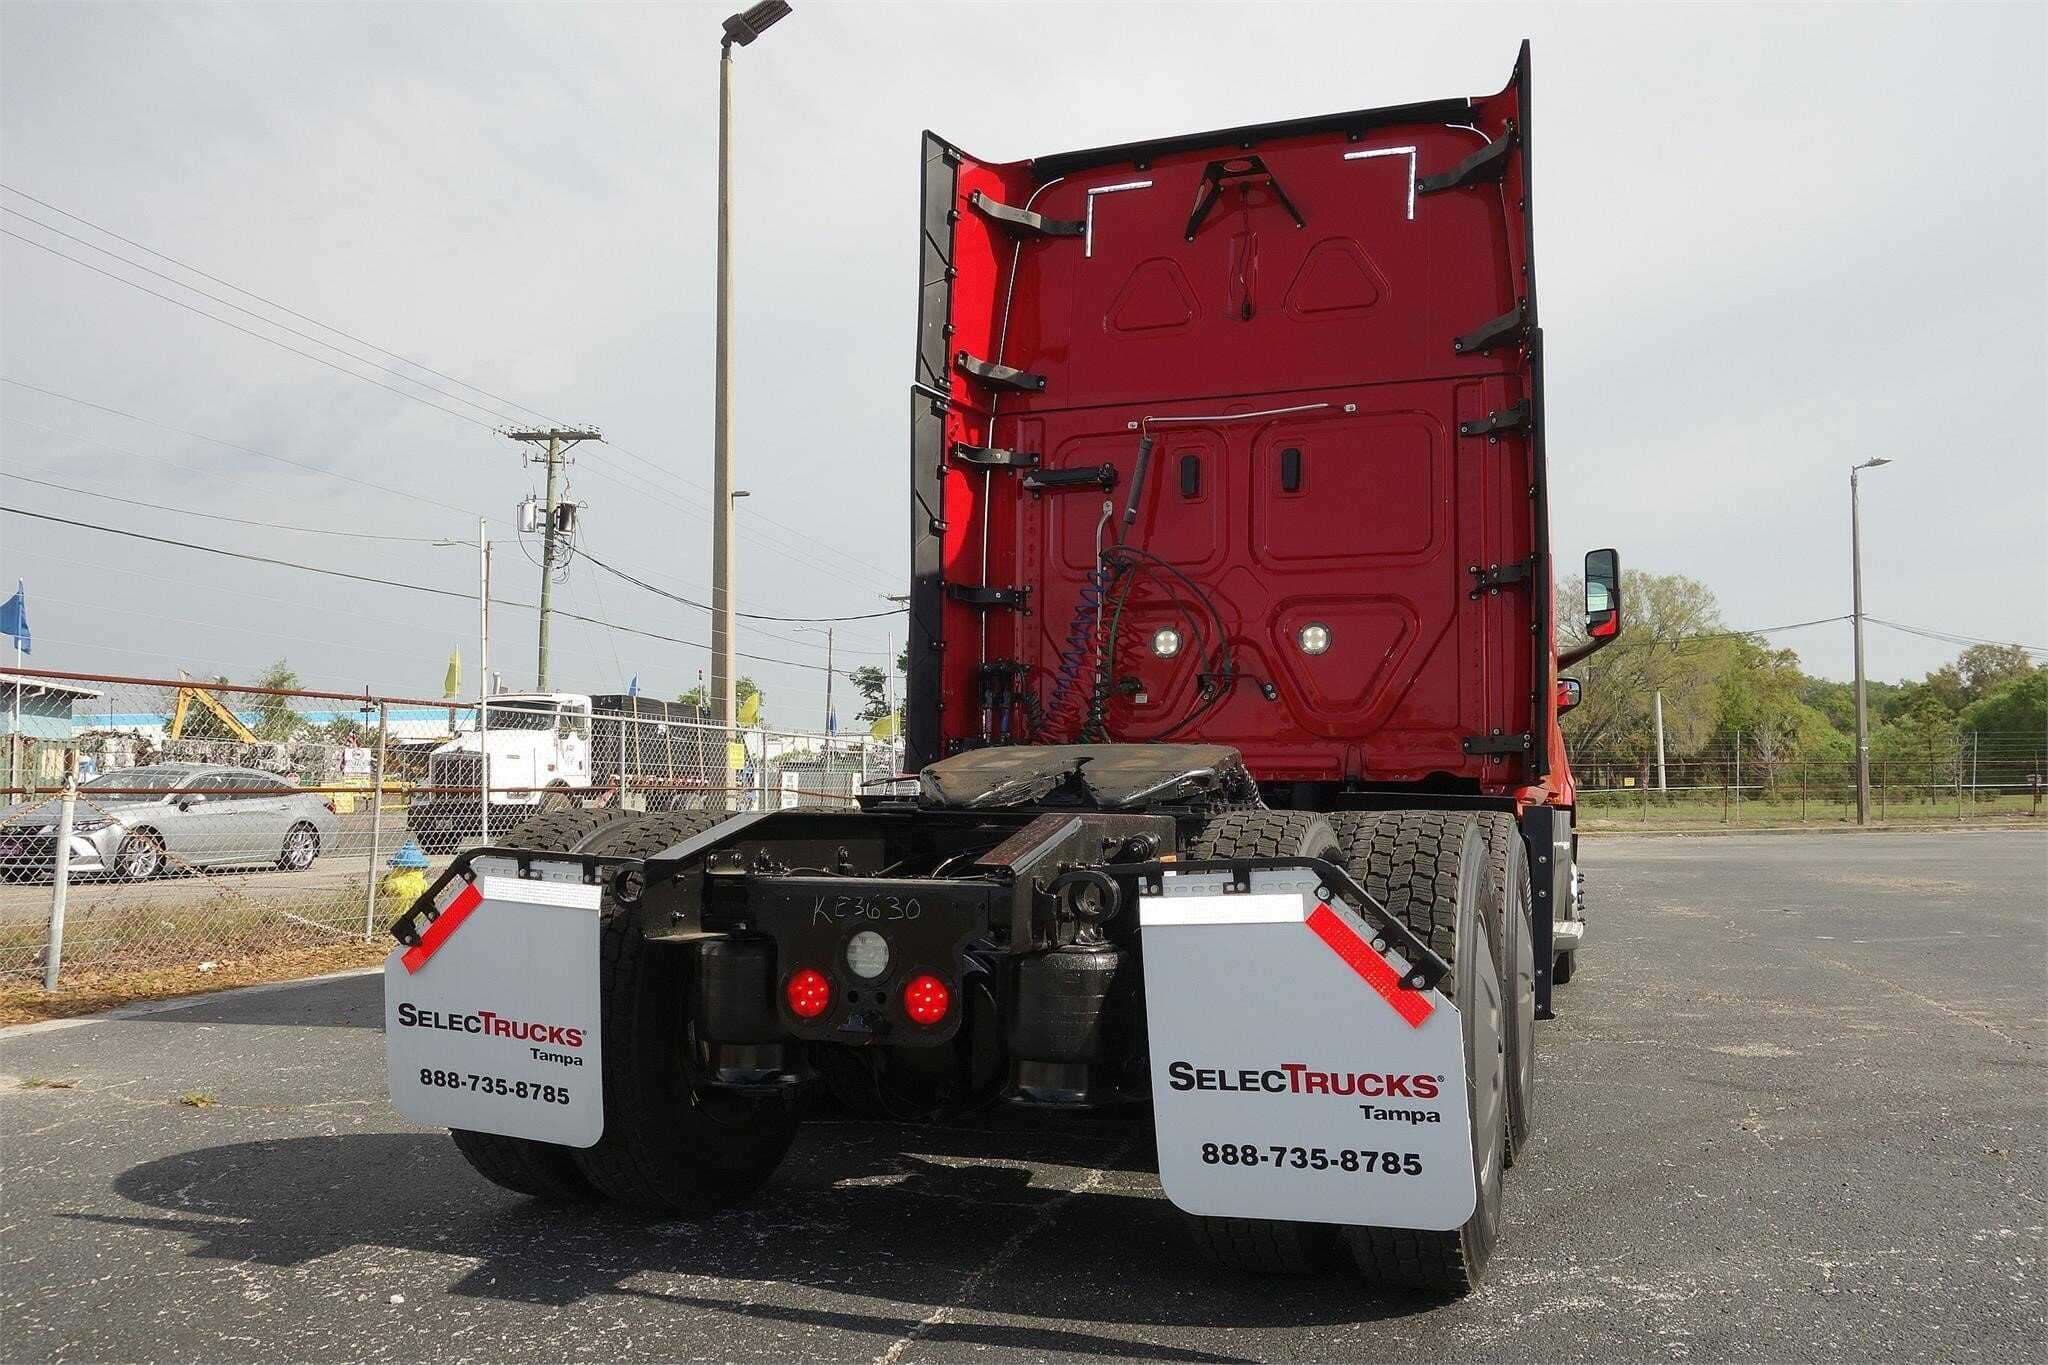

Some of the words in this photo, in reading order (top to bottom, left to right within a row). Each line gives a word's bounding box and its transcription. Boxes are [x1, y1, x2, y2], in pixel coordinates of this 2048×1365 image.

[530, 1047, 583, 1067] Tampa
[420, 1068, 570, 1105] 888-735-8785
[1359, 1104, 1441, 1125] Tampa
[1201, 1143, 1423, 1176] 888-735-8785
